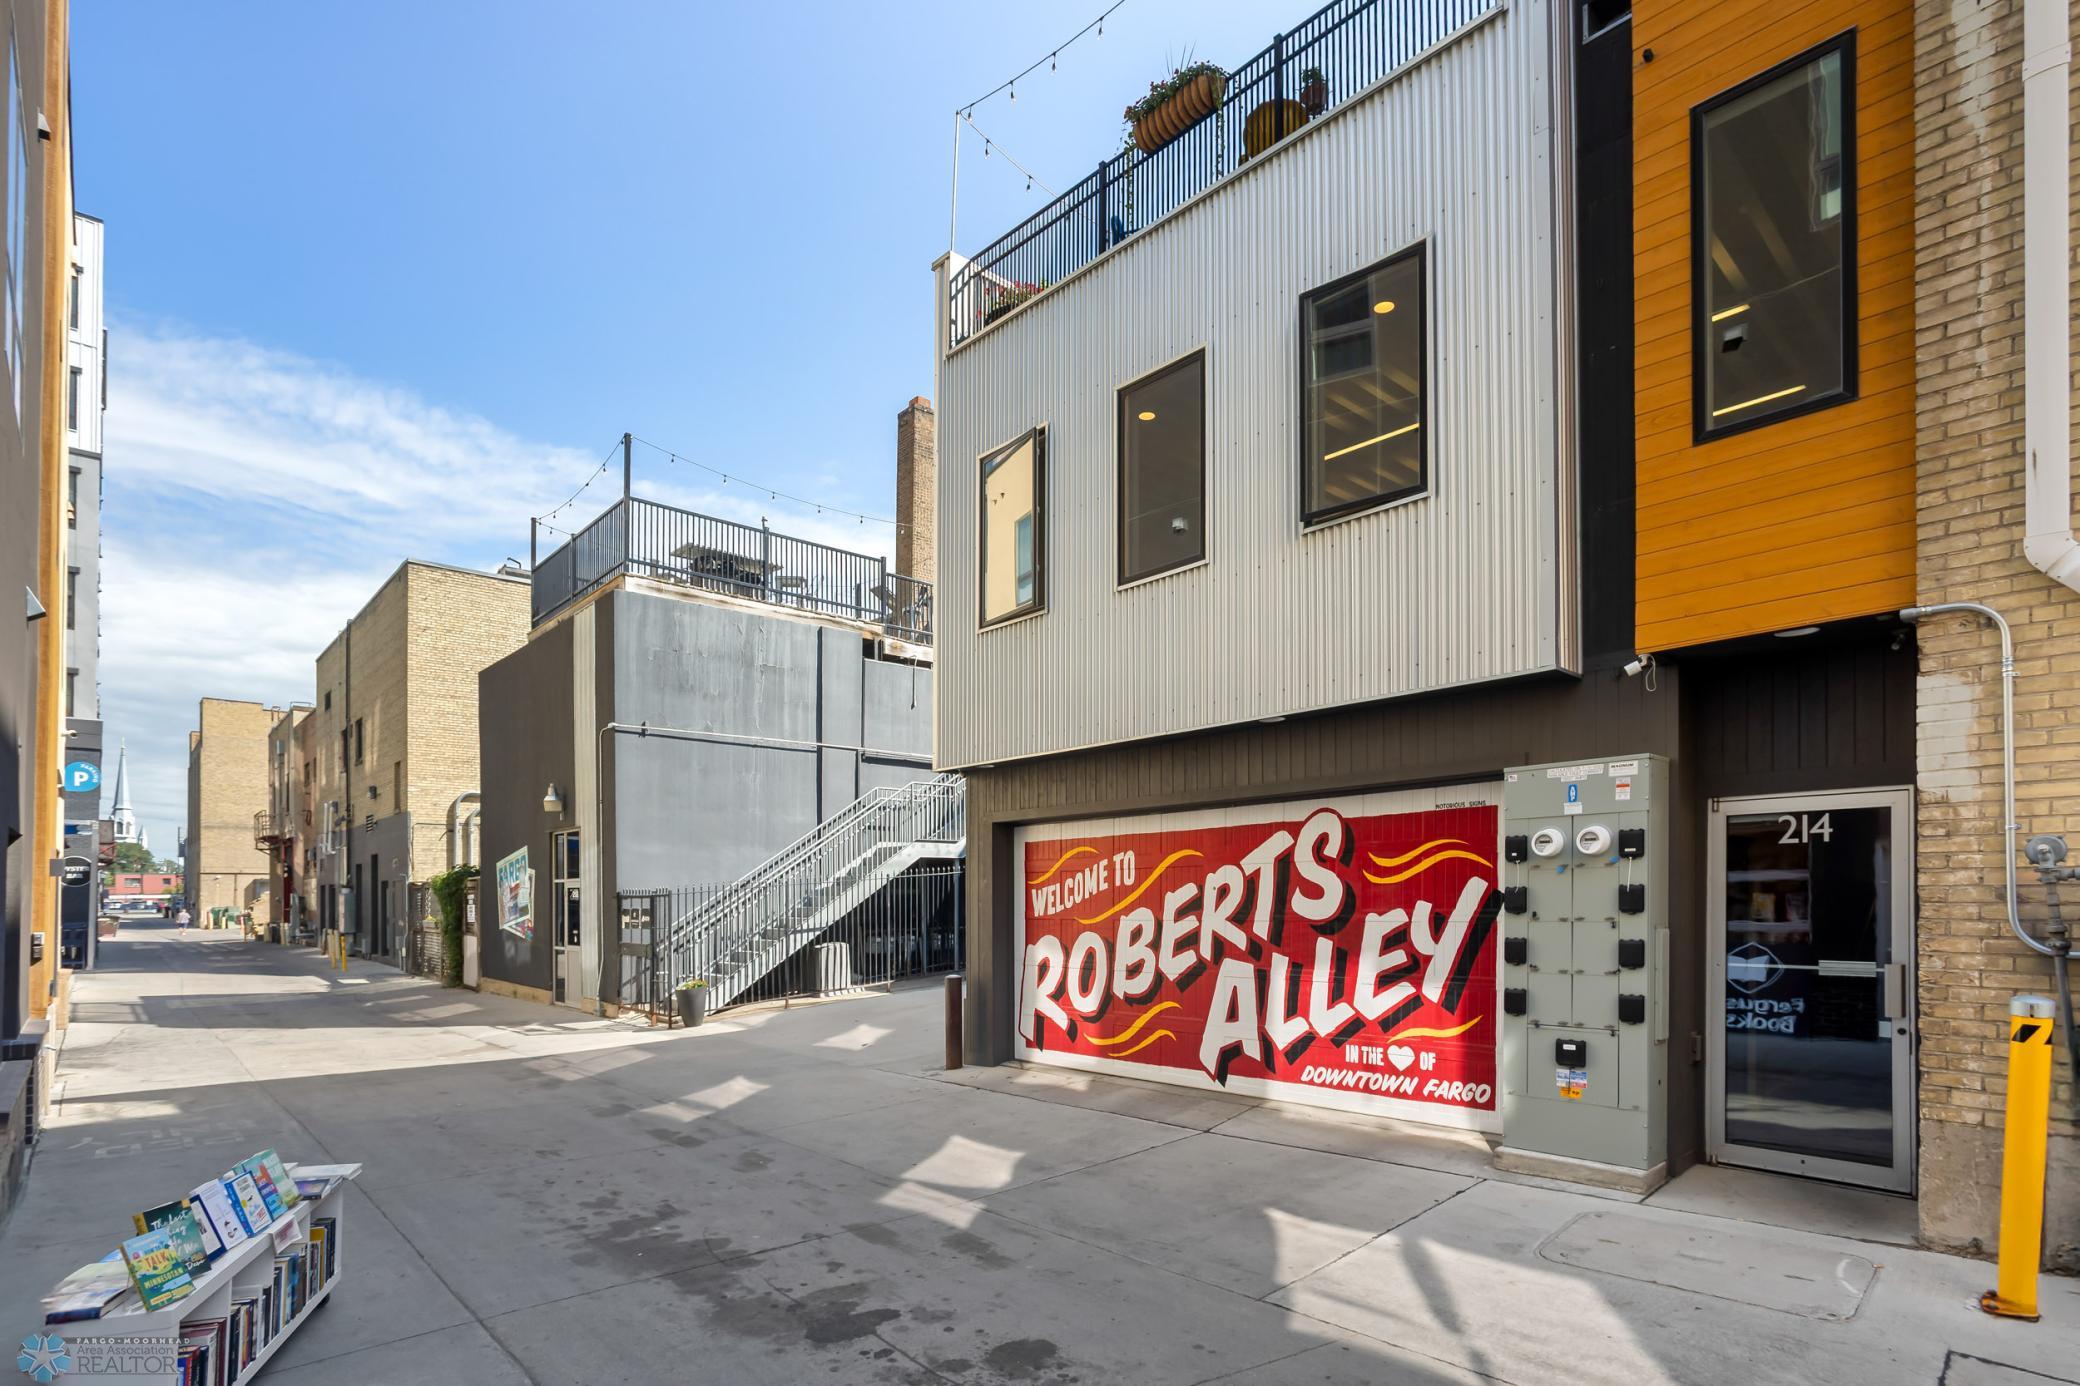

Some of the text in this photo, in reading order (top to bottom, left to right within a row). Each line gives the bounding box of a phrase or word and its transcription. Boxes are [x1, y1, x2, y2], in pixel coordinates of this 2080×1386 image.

[73, 771, 89, 787] P
[1435, 800, 1486, 810] NOTORIOUS SIGNS
[1778, 813, 1833, 844] 214
[1032, 850, 1136, 917] WELCOME TO
[1020, 812, 1344, 1041] ROBERTS
[1200, 876, 1488, 1075] ALLEY
[1345, 1045, 1437, 1071] IN THE OF
[1301, 1065, 1492, 1103] DOWNTOWN FARGO
[144, 1251, 168, 1269] TALK
[143, 1267, 184, 1289] MINNESOTAN
